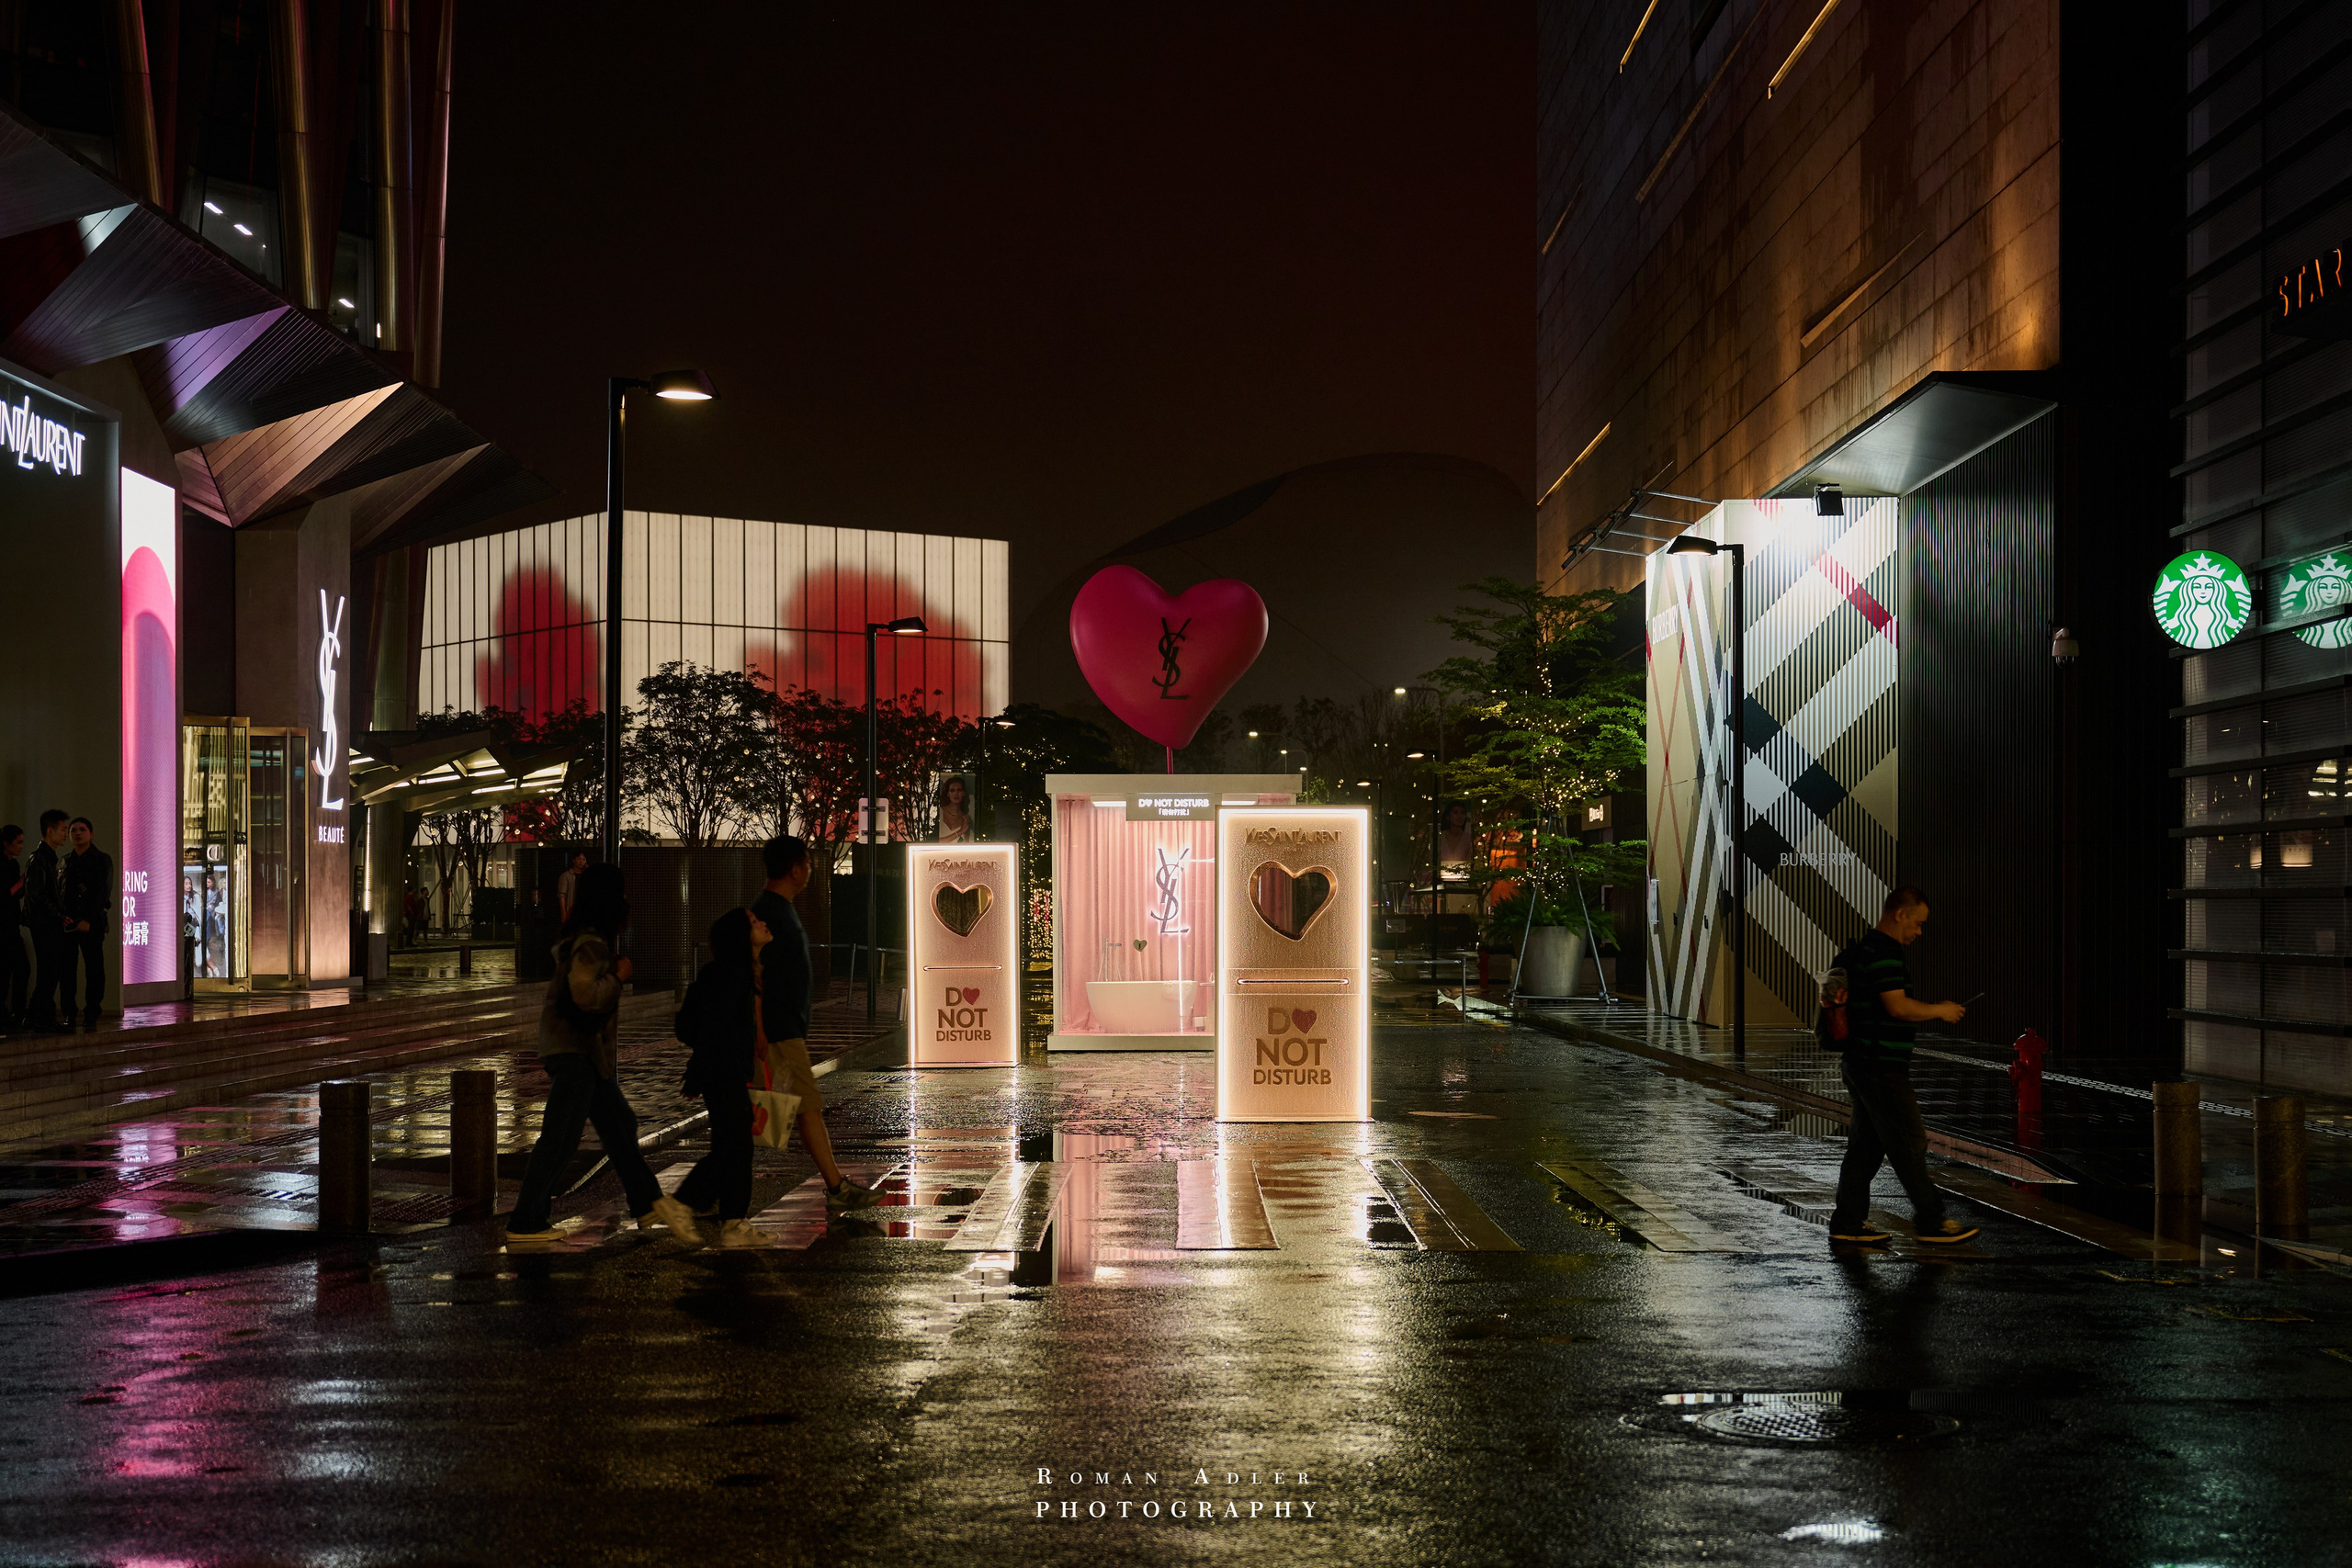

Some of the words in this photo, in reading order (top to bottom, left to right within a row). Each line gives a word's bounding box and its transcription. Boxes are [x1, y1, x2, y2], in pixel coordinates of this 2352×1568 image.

[1151, 617, 1193, 699] YSL
[1154, 798, 1172, 807] NOT
[1174, 798, 1209, 807] DISTURB
[318, 825, 345, 844] BEAUTÉ
[1780, 852, 1857, 866] BURBERRY
[123, 871, 148, 893] RING
[1150, 848, 1190, 933] YSL
[937, 1008, 988, 1028] NOT
[936, 1030, 991, 1042] DISTURB
[1256, 1038, 1327, 1066] NOT
[1253, 1069, 1332, 1085] DISTURB
